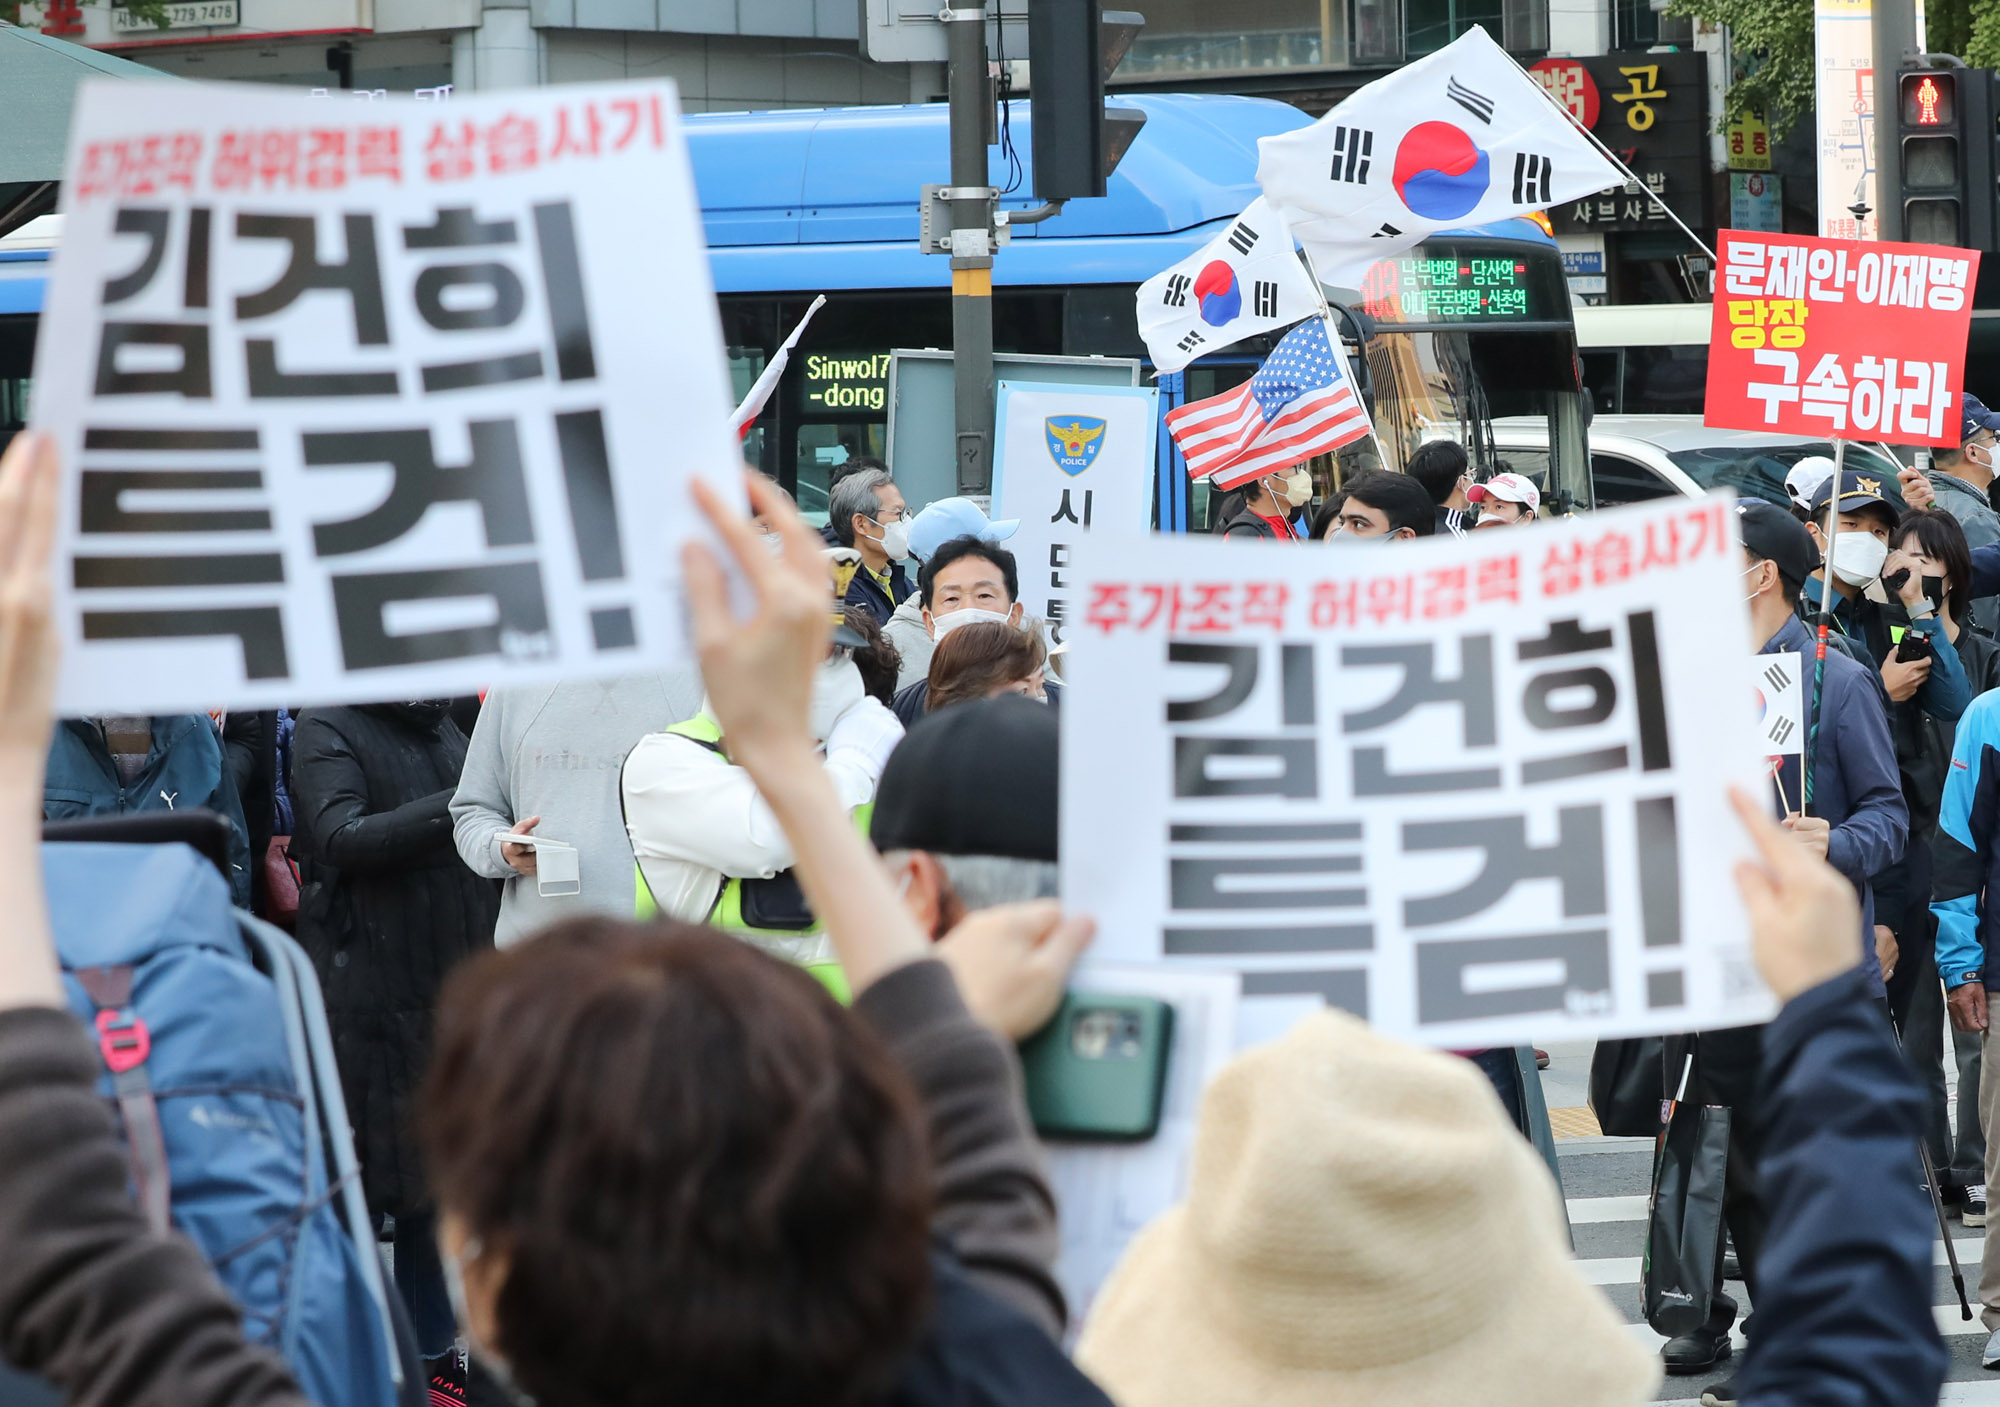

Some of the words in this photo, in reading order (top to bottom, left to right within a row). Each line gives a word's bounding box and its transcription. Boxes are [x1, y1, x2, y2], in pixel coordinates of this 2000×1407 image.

[1611, 64, 1668, 131] 공
[211, 123, 403, 190] 허위경력
[422, 95, 666, 182] 상습사기
[1573, 200, 1668, 224] 샤브샤브
[93, 199, 598, 398] 김건희
[1401, 289, 1481, 315] 이대목동병원
[1487, 289, 1527, 315] 신촌역
[1402, 260, 1458, 286] 남부법원
[1471, 260, 1515, 286] 당산역
[1725, 241, 1970, 311] 문재인·이재명
[1727, 299, 1809, 349] 당장
[807, 354, 892, 380] Sinwol7
[809, 382, 884, 410] -dong
[1747, 348, 1952, 438] 구속하라
[1060, 457, 1088, 466] POLICE
[73, 408, 638, 681] 특검!
[1085, 580, 1291, 634] 주가조작
[1309, 553, 1522, 630] 허위경력
[1540, 502, 1732, 599] 상습사기
[1165, 608, 1672, 800] 김건희
[1162, 795, 1686, 1027] 특검!
